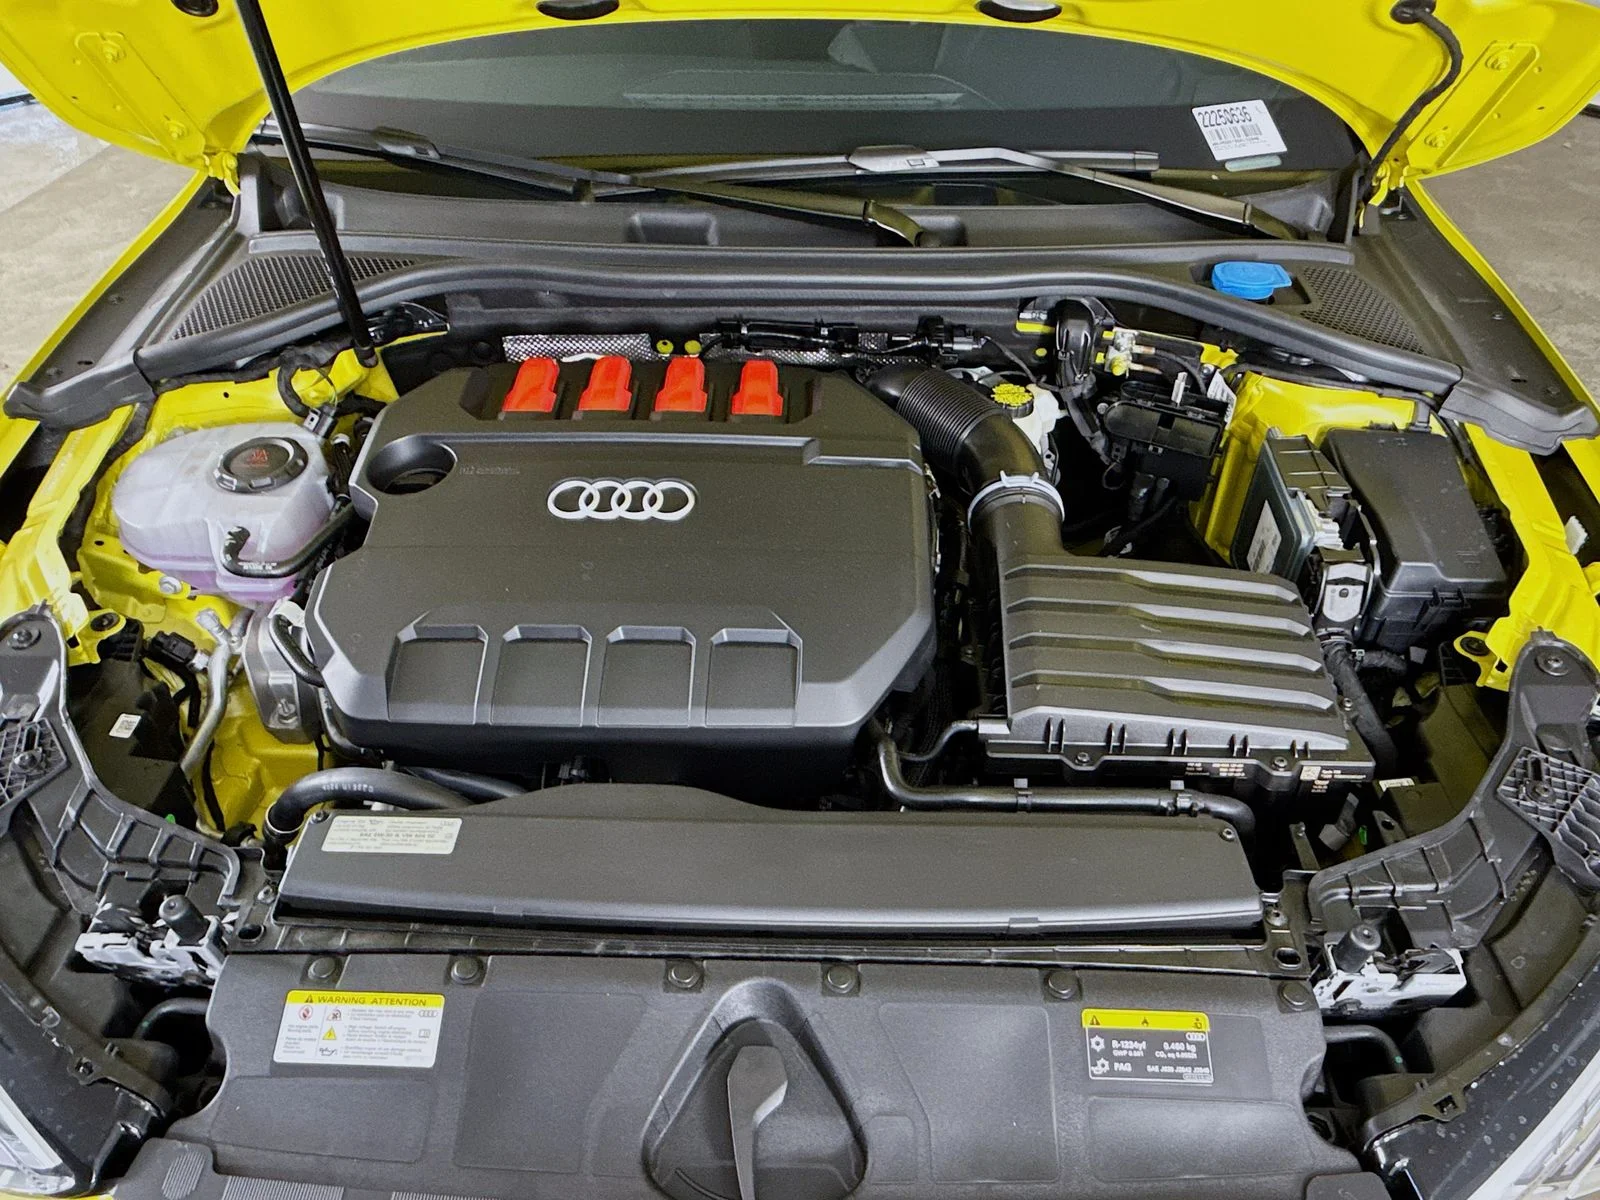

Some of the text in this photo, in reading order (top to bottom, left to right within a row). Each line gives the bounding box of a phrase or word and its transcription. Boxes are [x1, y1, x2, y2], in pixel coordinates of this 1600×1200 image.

[1198, 106, 1252, 128] 22250636
[318, 996, 427, 1006] WARNING ATTENTION
[1186, 1042, 1197, 1053] kg
[1113, 1062, 1132, 1072] PAG
